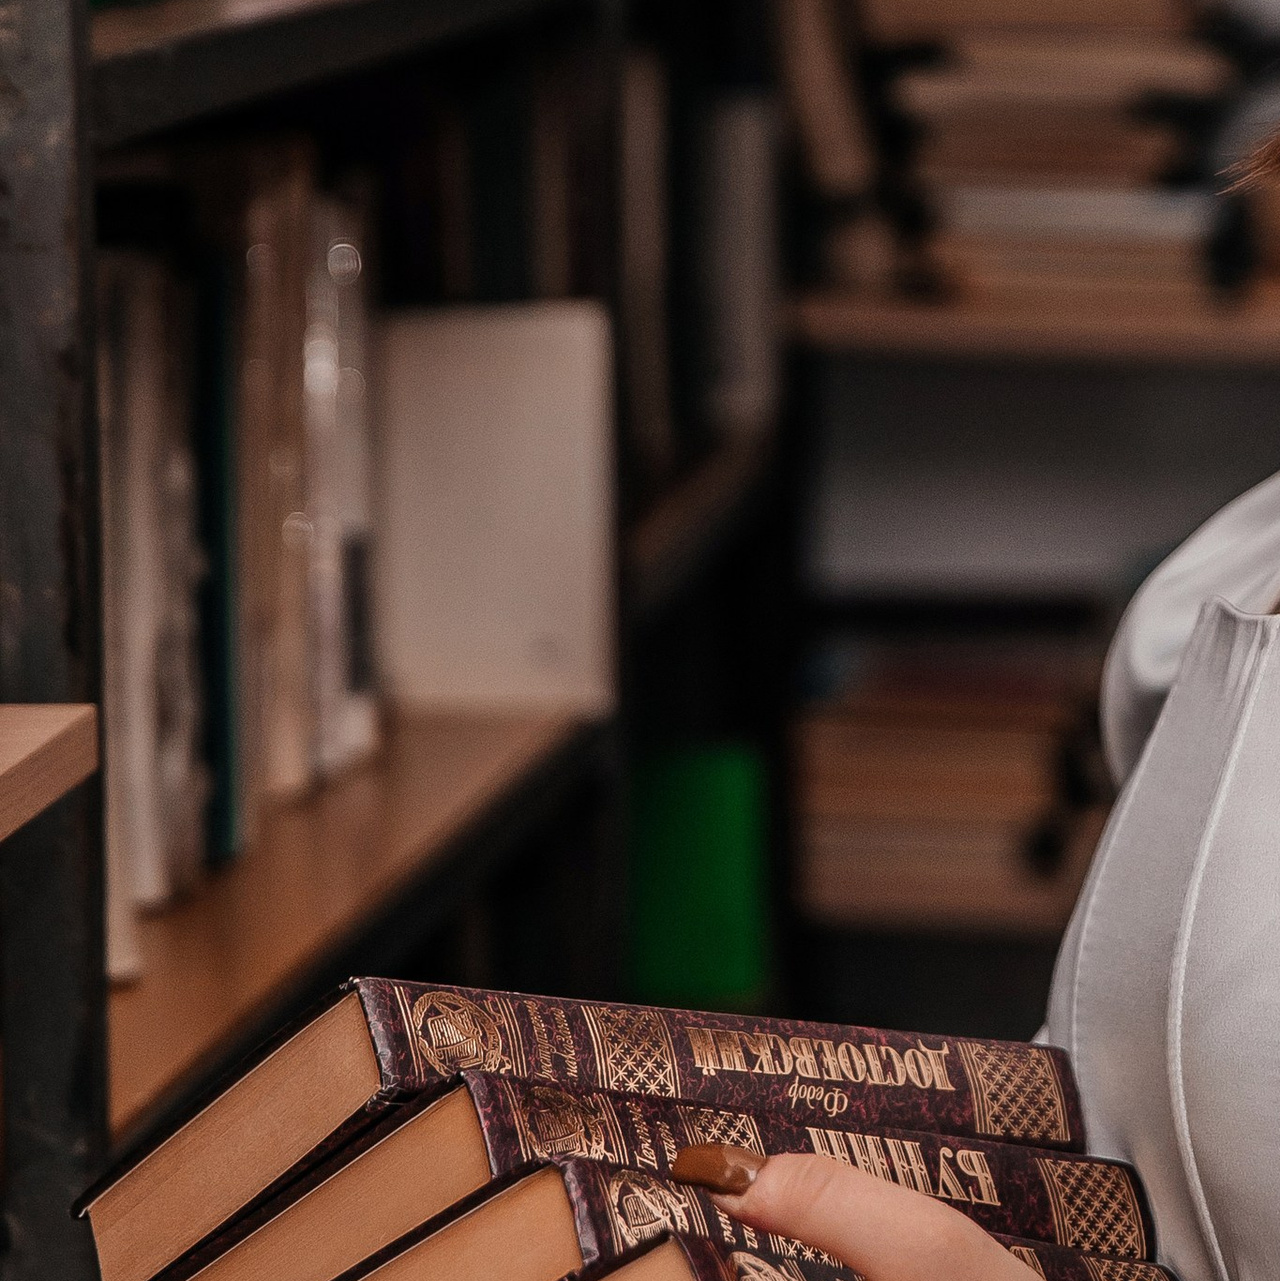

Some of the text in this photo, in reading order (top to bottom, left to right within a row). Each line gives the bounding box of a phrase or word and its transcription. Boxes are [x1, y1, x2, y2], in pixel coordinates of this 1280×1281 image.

[684, 1025, 956, 1092] ДОСТОЕВСКИЙ
[787, 1076, 849, 1118] Федор
[805, 1126, 1001, 1206] БУНИН
